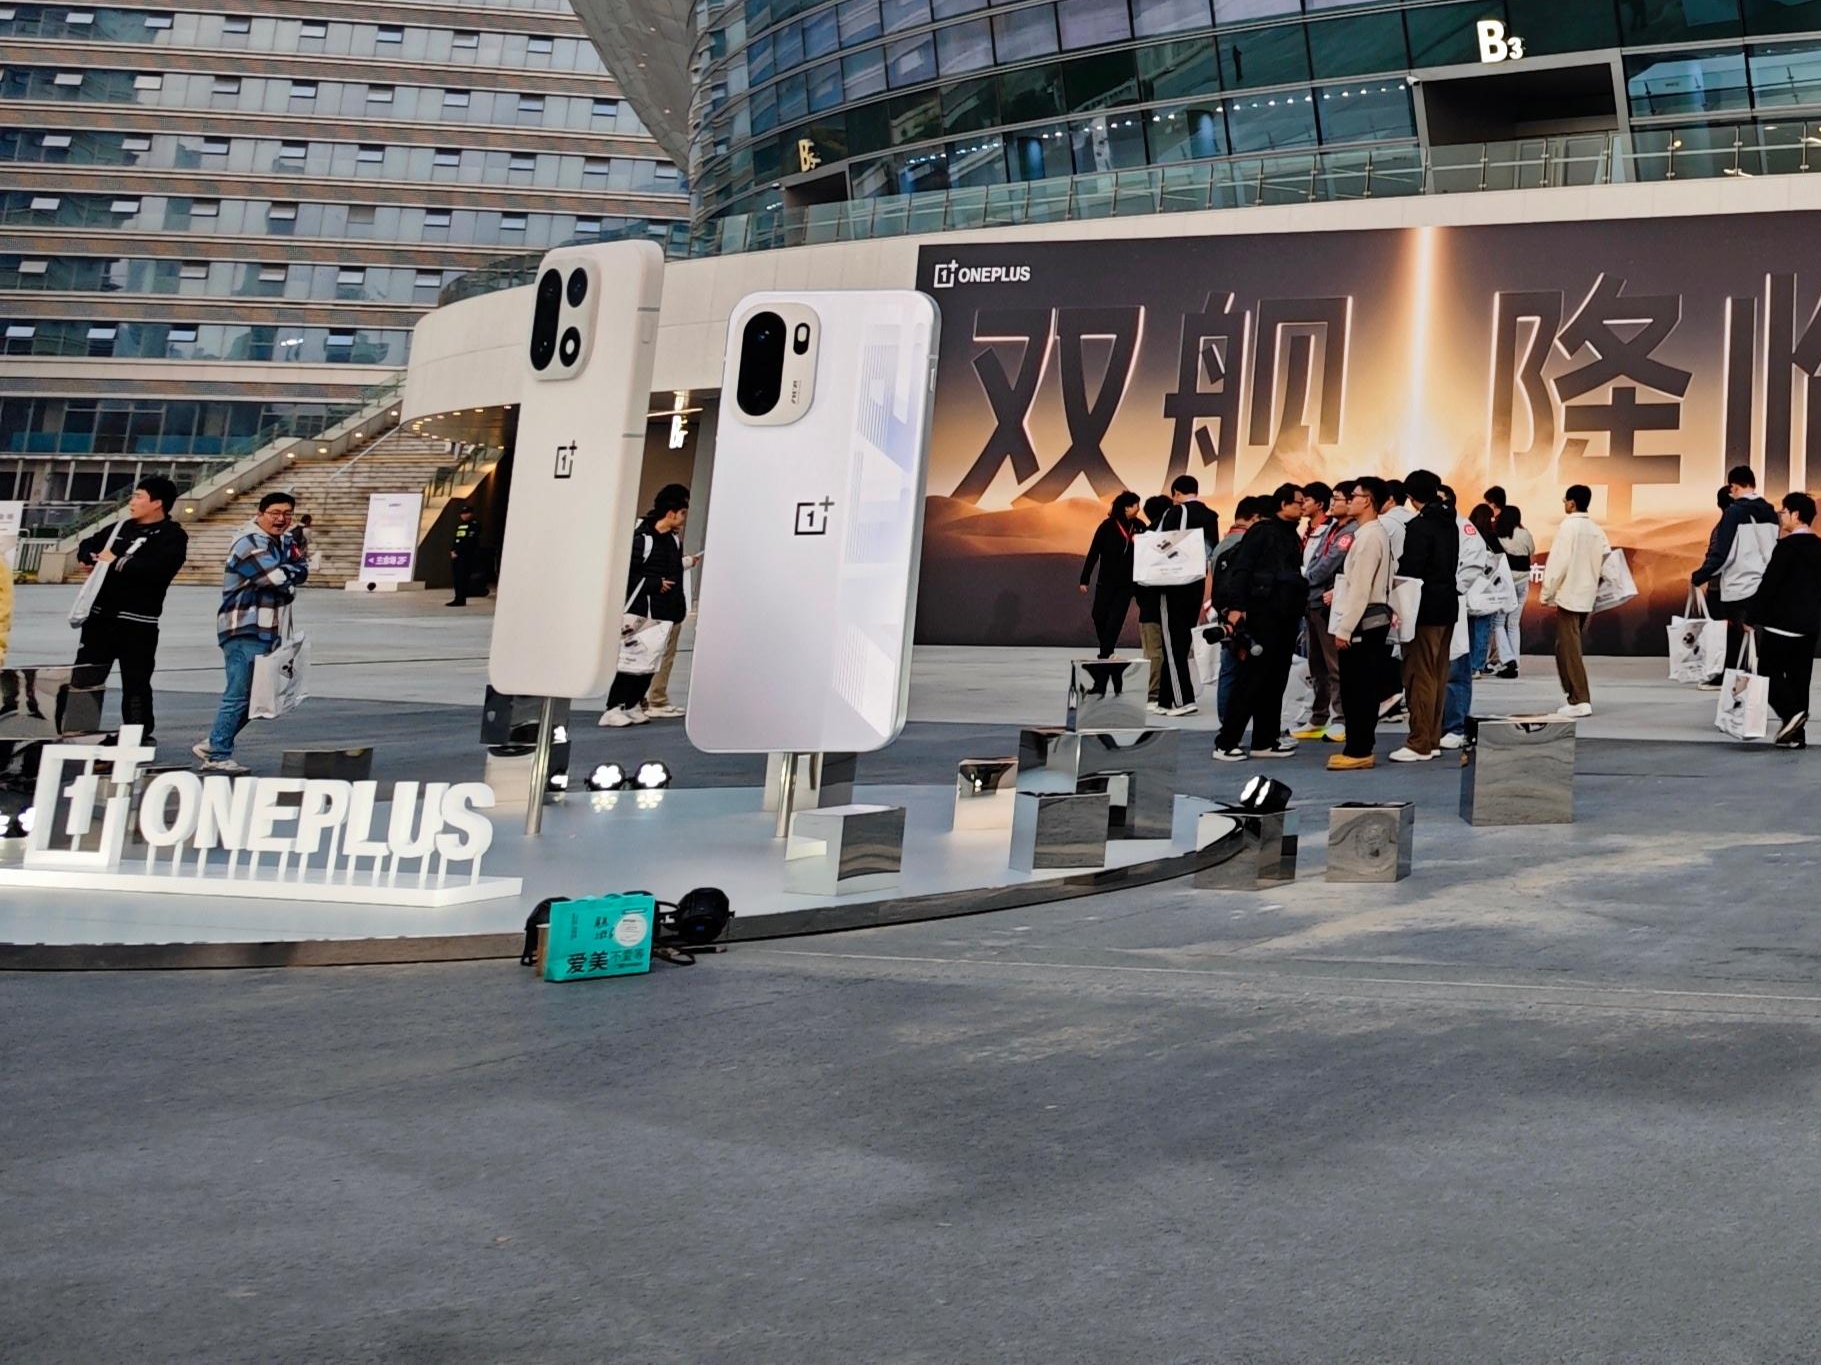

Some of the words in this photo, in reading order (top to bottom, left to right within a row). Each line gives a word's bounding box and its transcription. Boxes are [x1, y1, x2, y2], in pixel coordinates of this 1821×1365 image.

[1477, 20, 1525, 63] B3
[958, 265, 1031, 284] ONEPLUS
[140, 770, 496, 862] ONEPLUS
